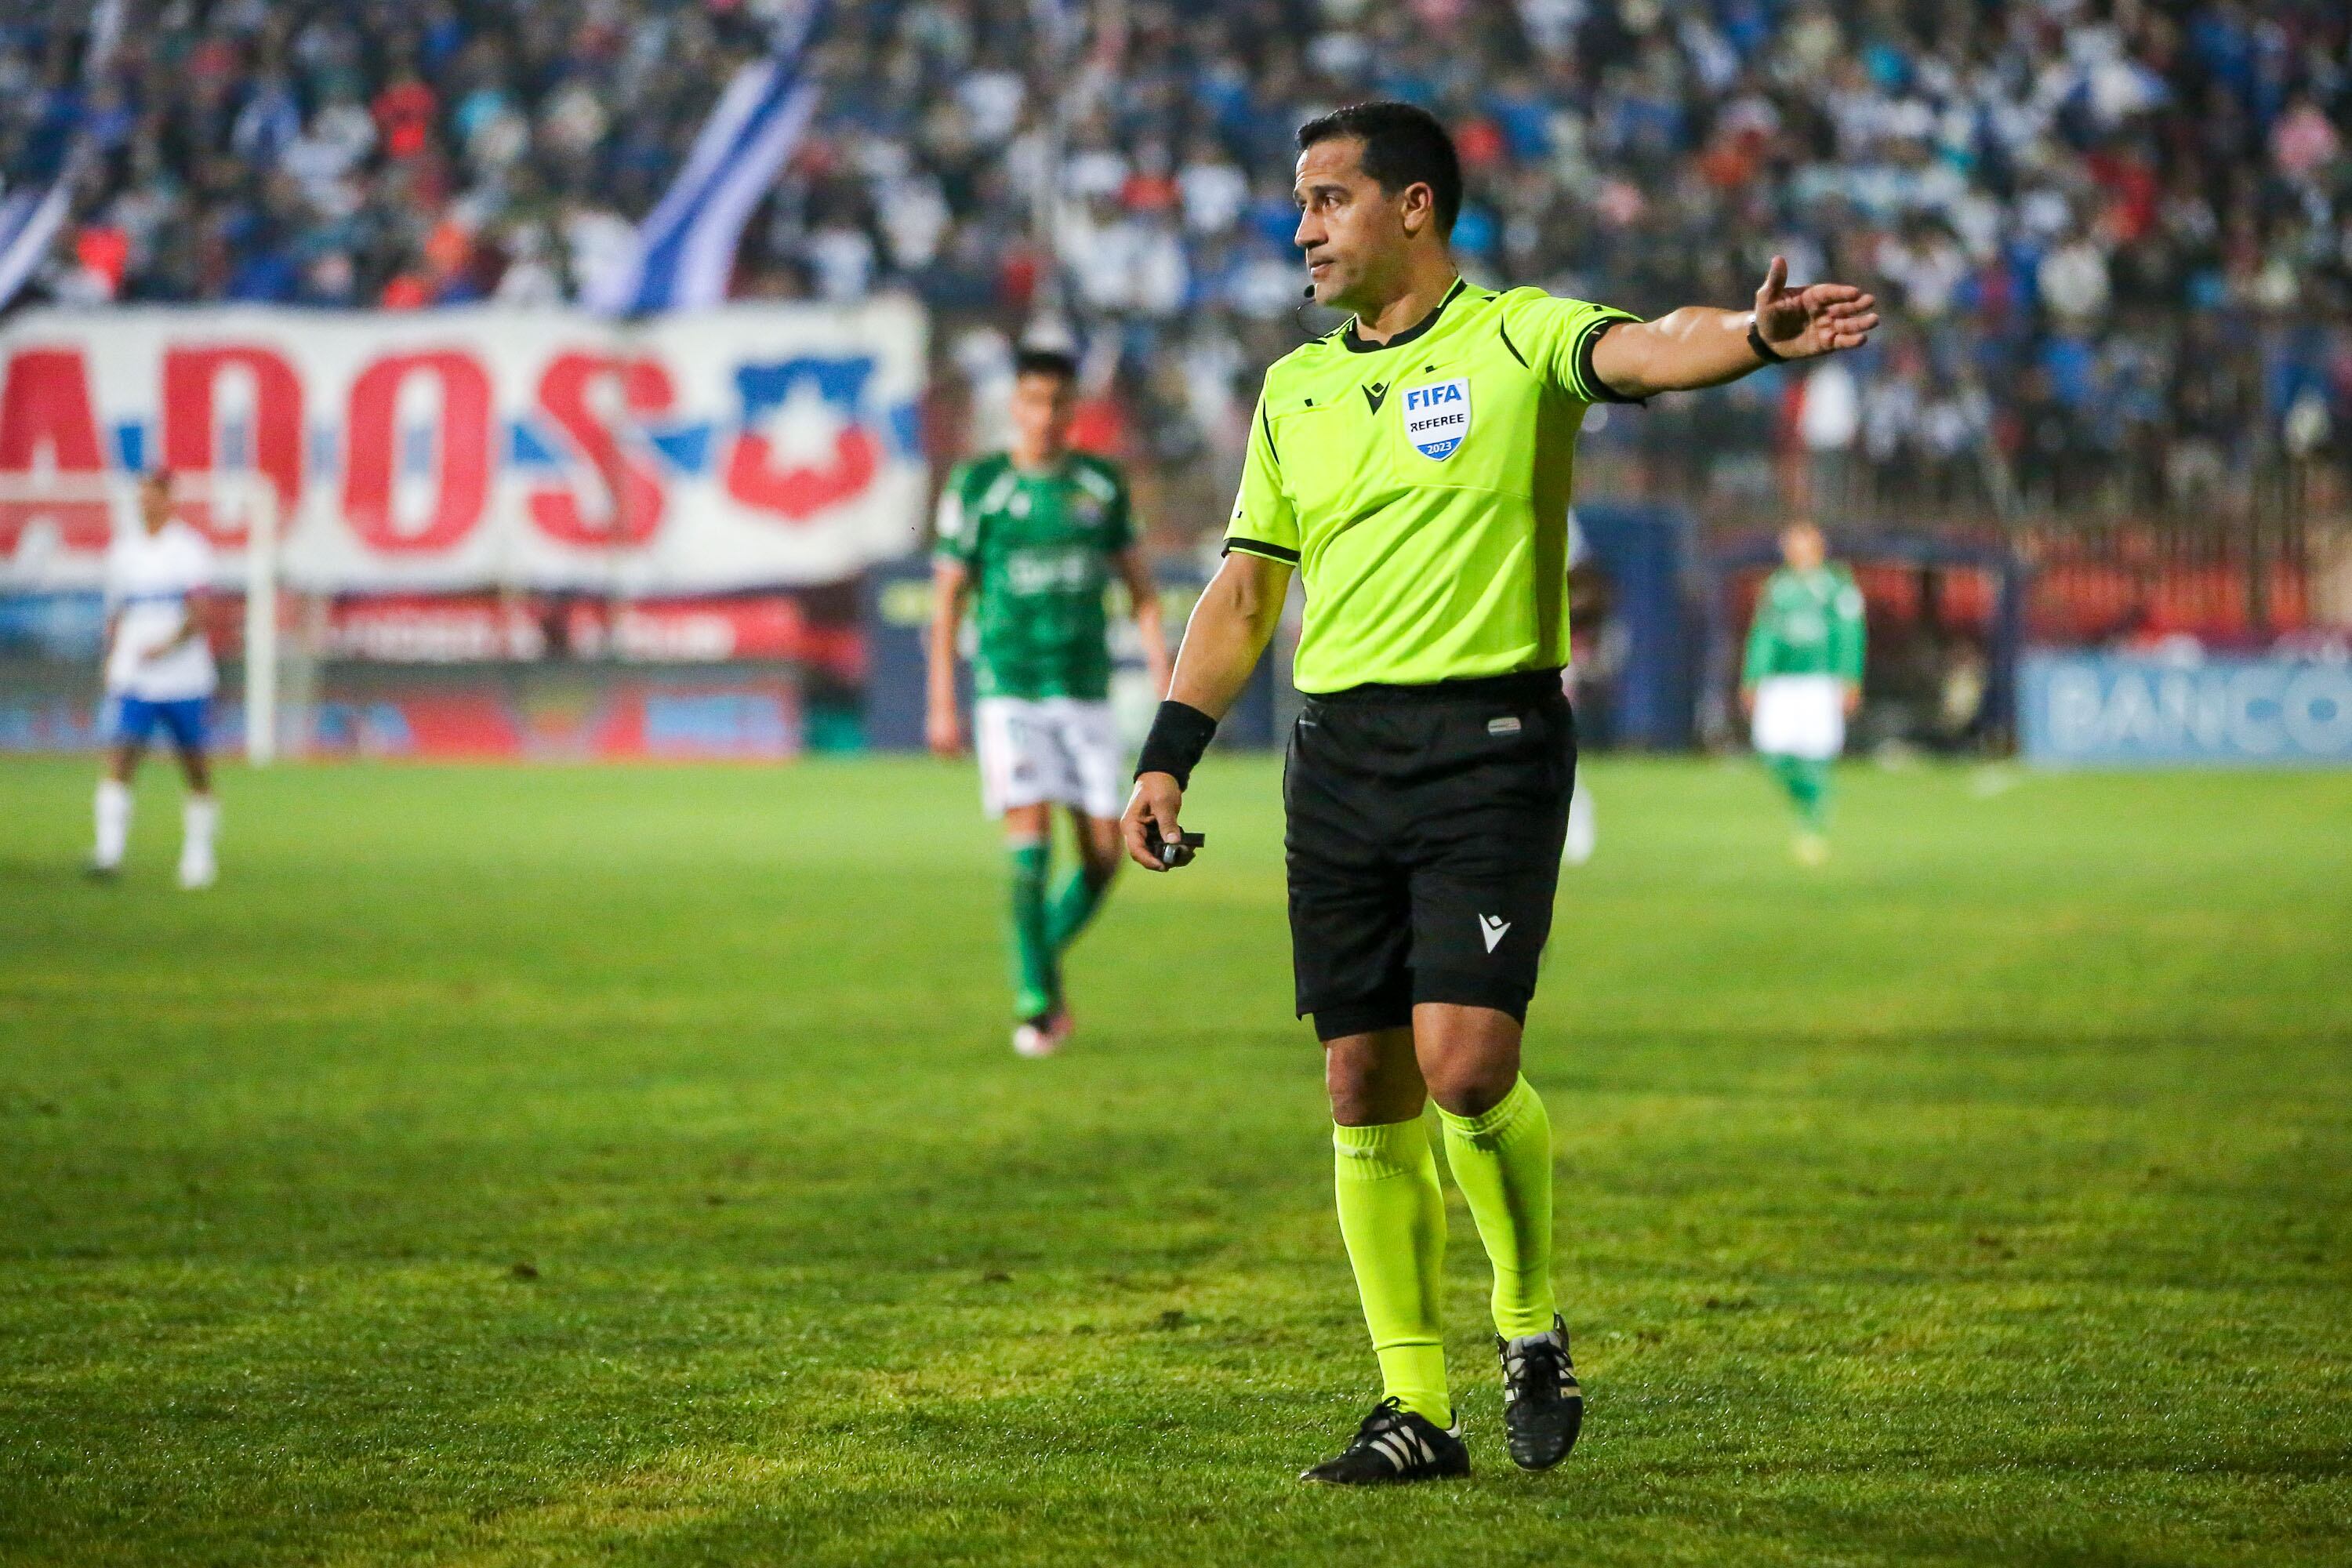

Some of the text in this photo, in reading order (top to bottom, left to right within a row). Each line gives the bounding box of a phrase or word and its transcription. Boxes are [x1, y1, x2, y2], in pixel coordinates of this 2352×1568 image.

[1407, 384, 1462, 411] FIFA
[1410, 413, 1465, 433] REFEREE
[1427, 441, 1452, 455] 2023
[2045, 661, 2352, 754] BANCO
